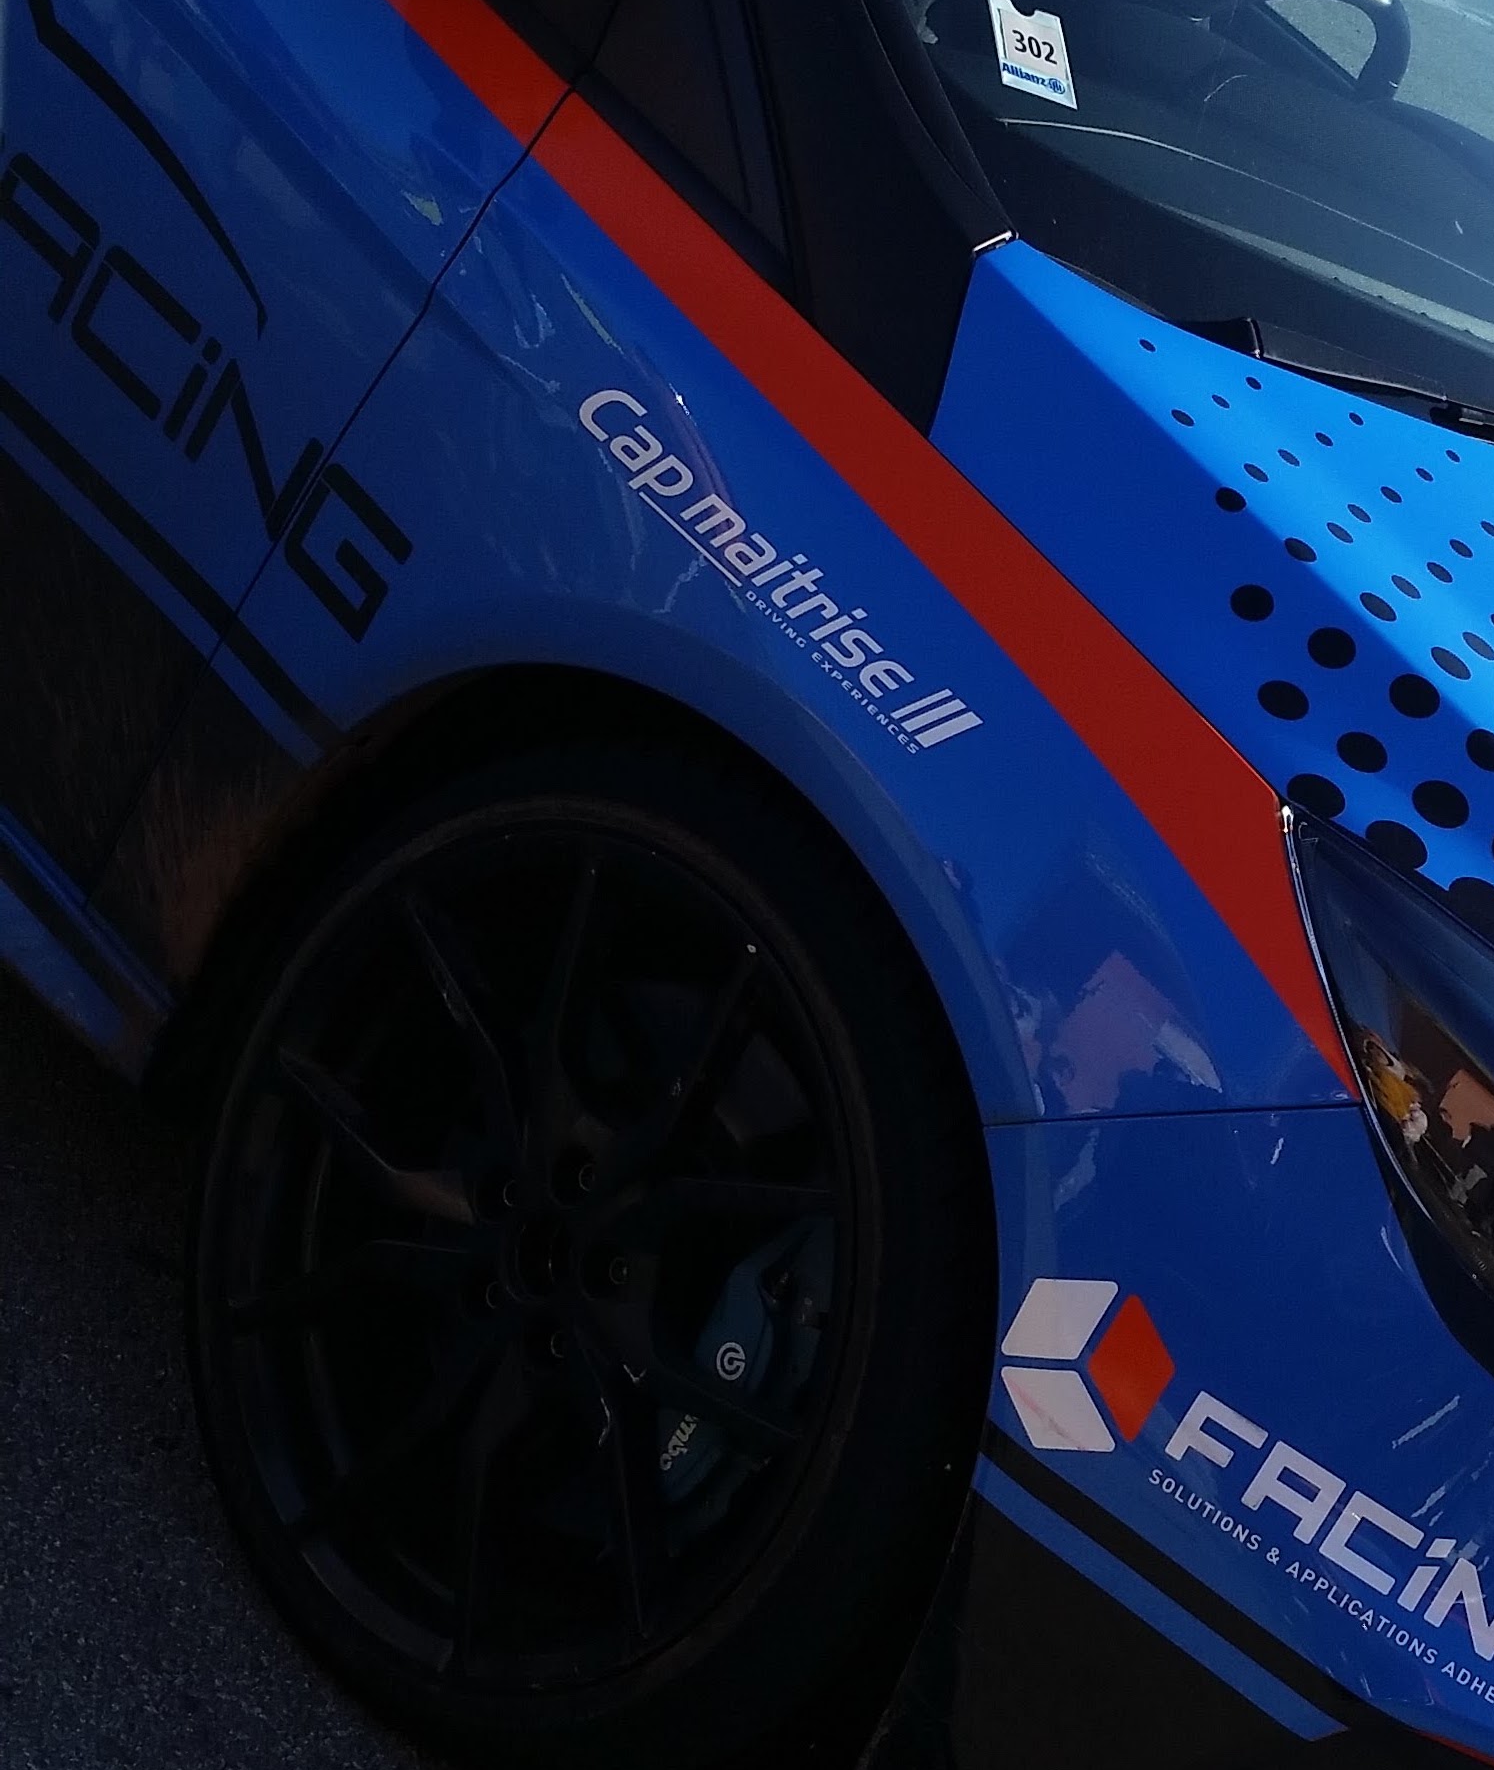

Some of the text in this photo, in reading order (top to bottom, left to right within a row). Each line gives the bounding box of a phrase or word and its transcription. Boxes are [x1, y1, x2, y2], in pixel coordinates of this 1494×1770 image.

[1002, 62, 1047, 87] Allianz
[1011, 29, 1058, 65] 302
[579, 389, 915, 699] Cap maitrise
[745, 590, 920, 755] DRIVING EXPERIENCES
[1149, 1468, 1262, 1551] SOLUTIONS
[1265, 1547, 1280, 1566] &
[1285, 1561, 1440, 1665] APPLICATIONS
